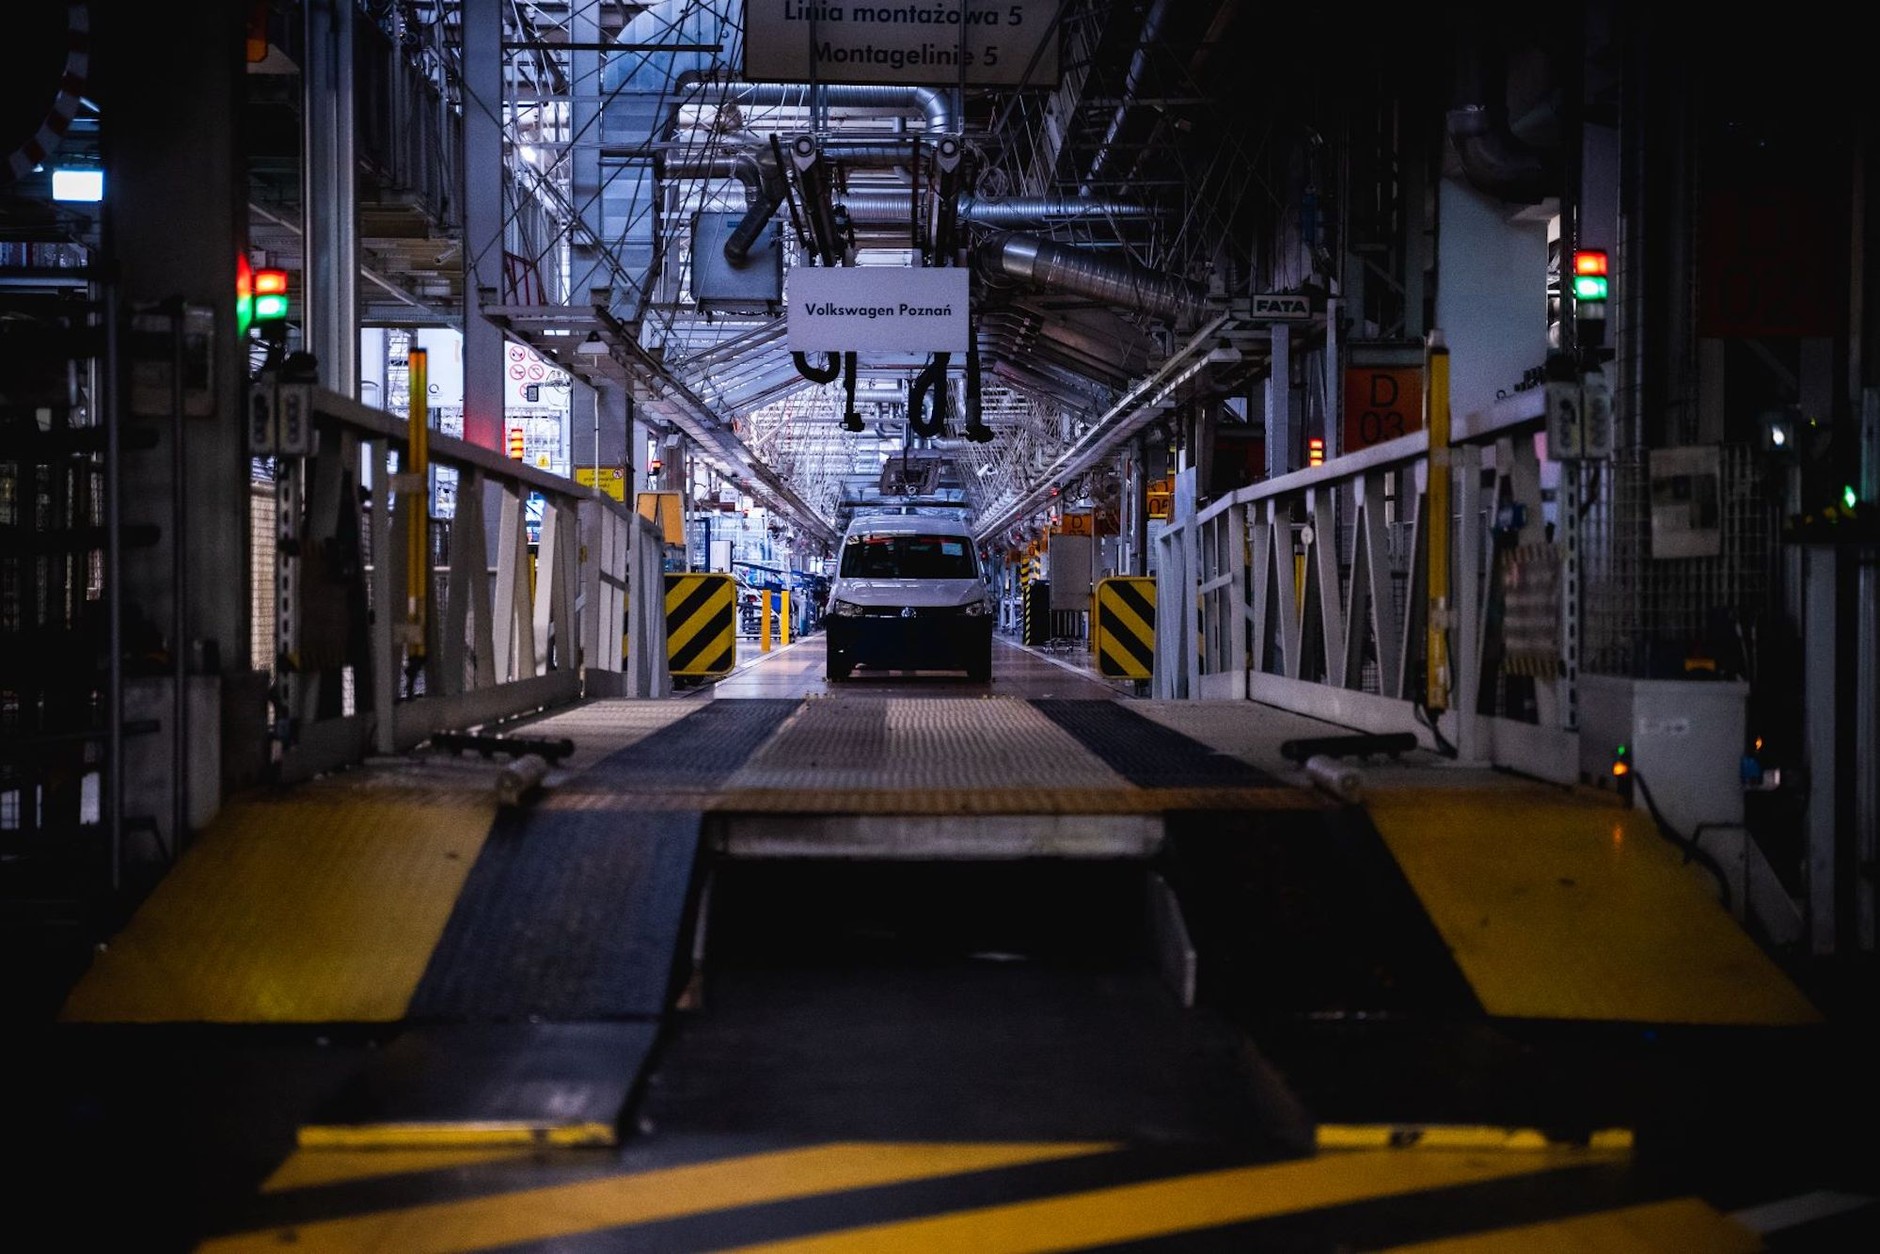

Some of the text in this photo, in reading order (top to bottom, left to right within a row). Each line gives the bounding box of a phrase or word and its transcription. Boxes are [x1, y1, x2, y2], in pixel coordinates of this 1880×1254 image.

[785, 0, 1023, 25] Linia montażowa 5
[814, 42, 998, 69] Montagelinie 5
[805, 303, 952, 319] Volkswagen Poznań
[1256, 300, 1307, 312] FATA
[1370, 374, 1398, 408] D
[1360, 411, 1405, 443] 03
[1071, 515, 1083, 529] D
